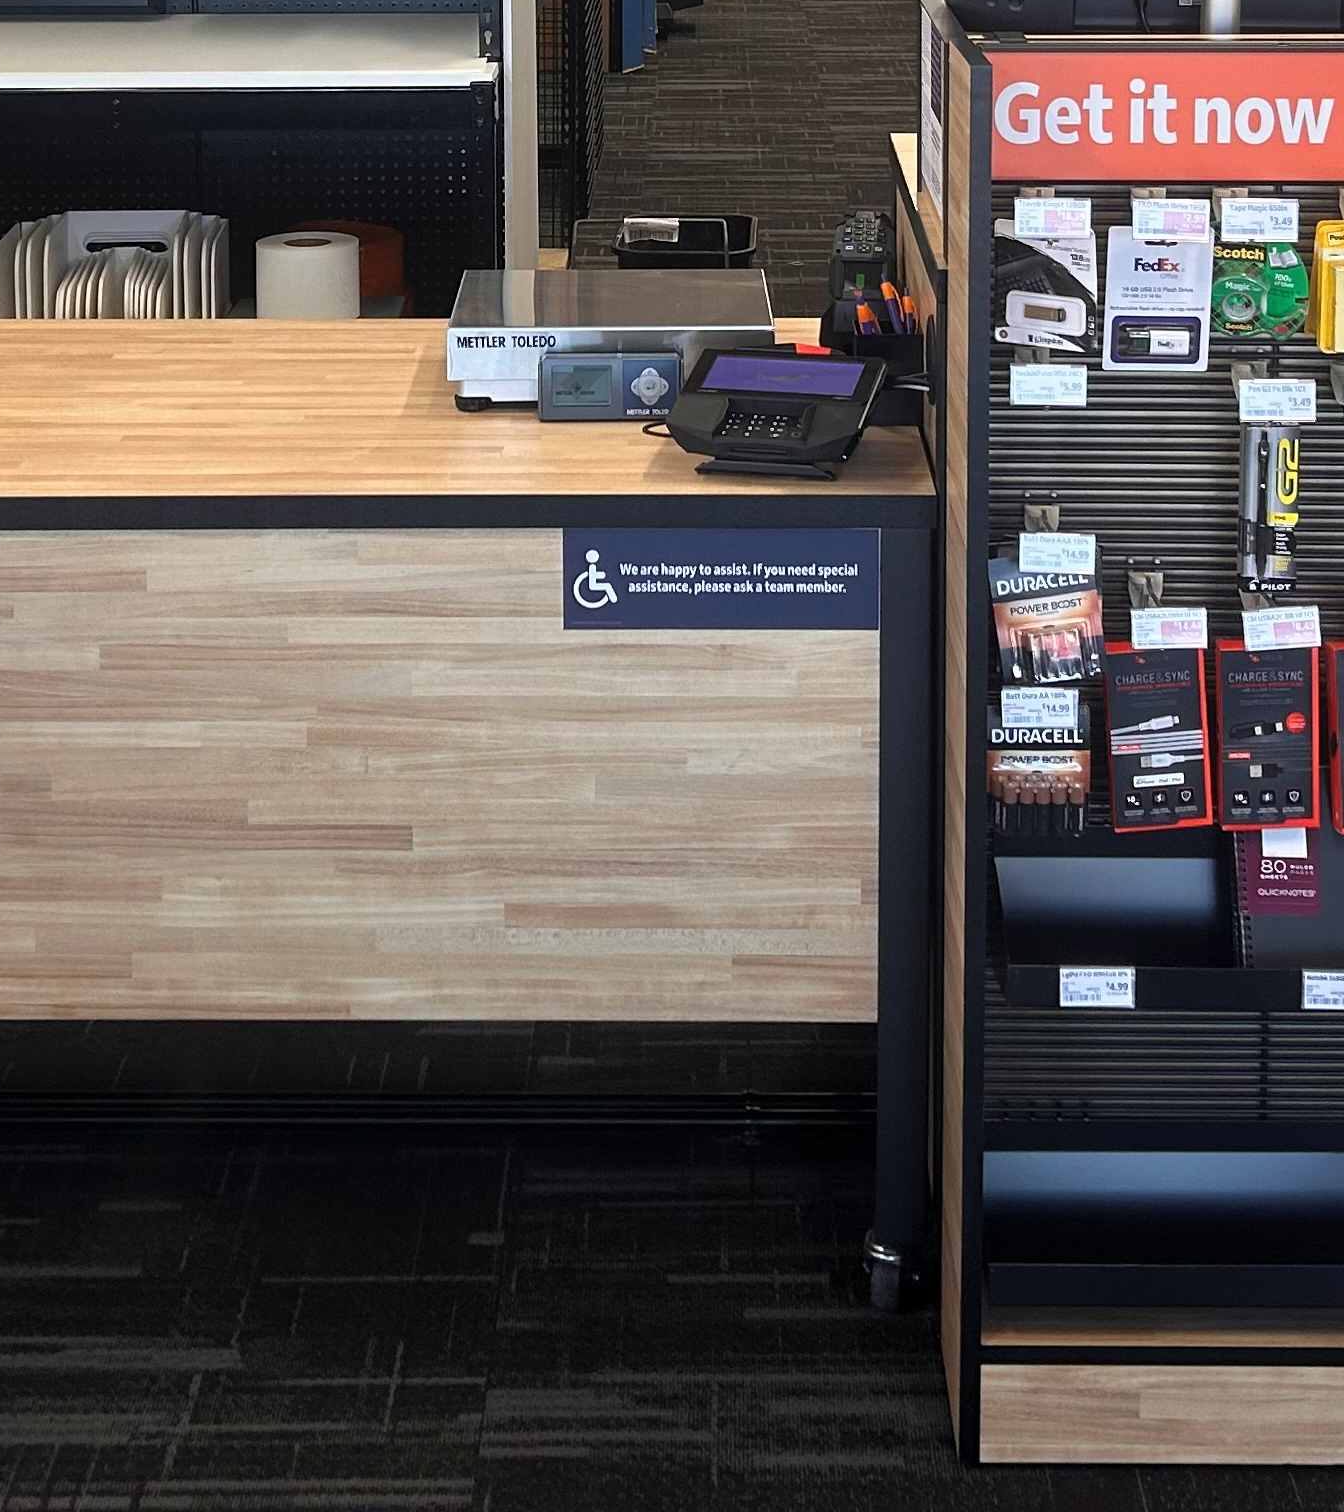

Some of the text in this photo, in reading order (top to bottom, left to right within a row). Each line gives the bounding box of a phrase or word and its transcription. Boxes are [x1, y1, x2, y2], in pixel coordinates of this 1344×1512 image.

[993, 78, 1335, 145] Get it now
[1214, 246, 1265, 260] Scotch
[1134, 258, 1180, 272] FedEx
[457, 335, 556, 348] METTLER TOLEDO
[619, 563, 858, 579] We are happy to assist. If you need special
[628, 580, 847, 595] assistance, please ask a team member.
[996, 572, 1089, 596] DURACELL
[1261, 583, 1292, 591] PILOT
[1010, 597, 1083, 616] POWER BOOST
[991, 728, 1083, 744] DURACELL
[1261, 859, 1287, 874] 80
